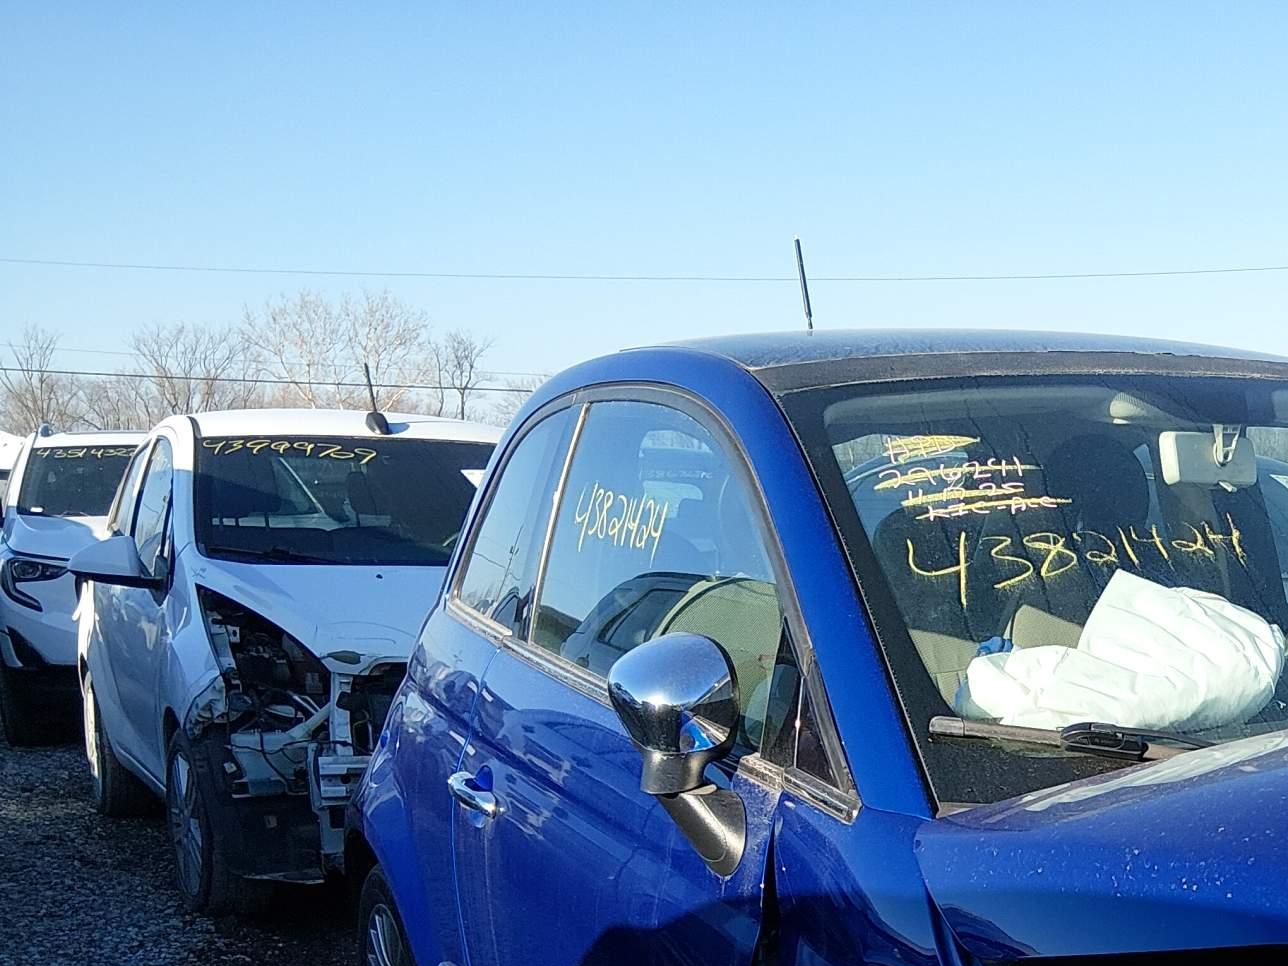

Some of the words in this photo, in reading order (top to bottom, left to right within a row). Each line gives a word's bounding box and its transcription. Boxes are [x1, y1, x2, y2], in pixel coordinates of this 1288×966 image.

[203, 439, 377, 465] 43999709
[574, 480, 669, 568] 43821424
[906, 512, 1249, 610] 43821424
